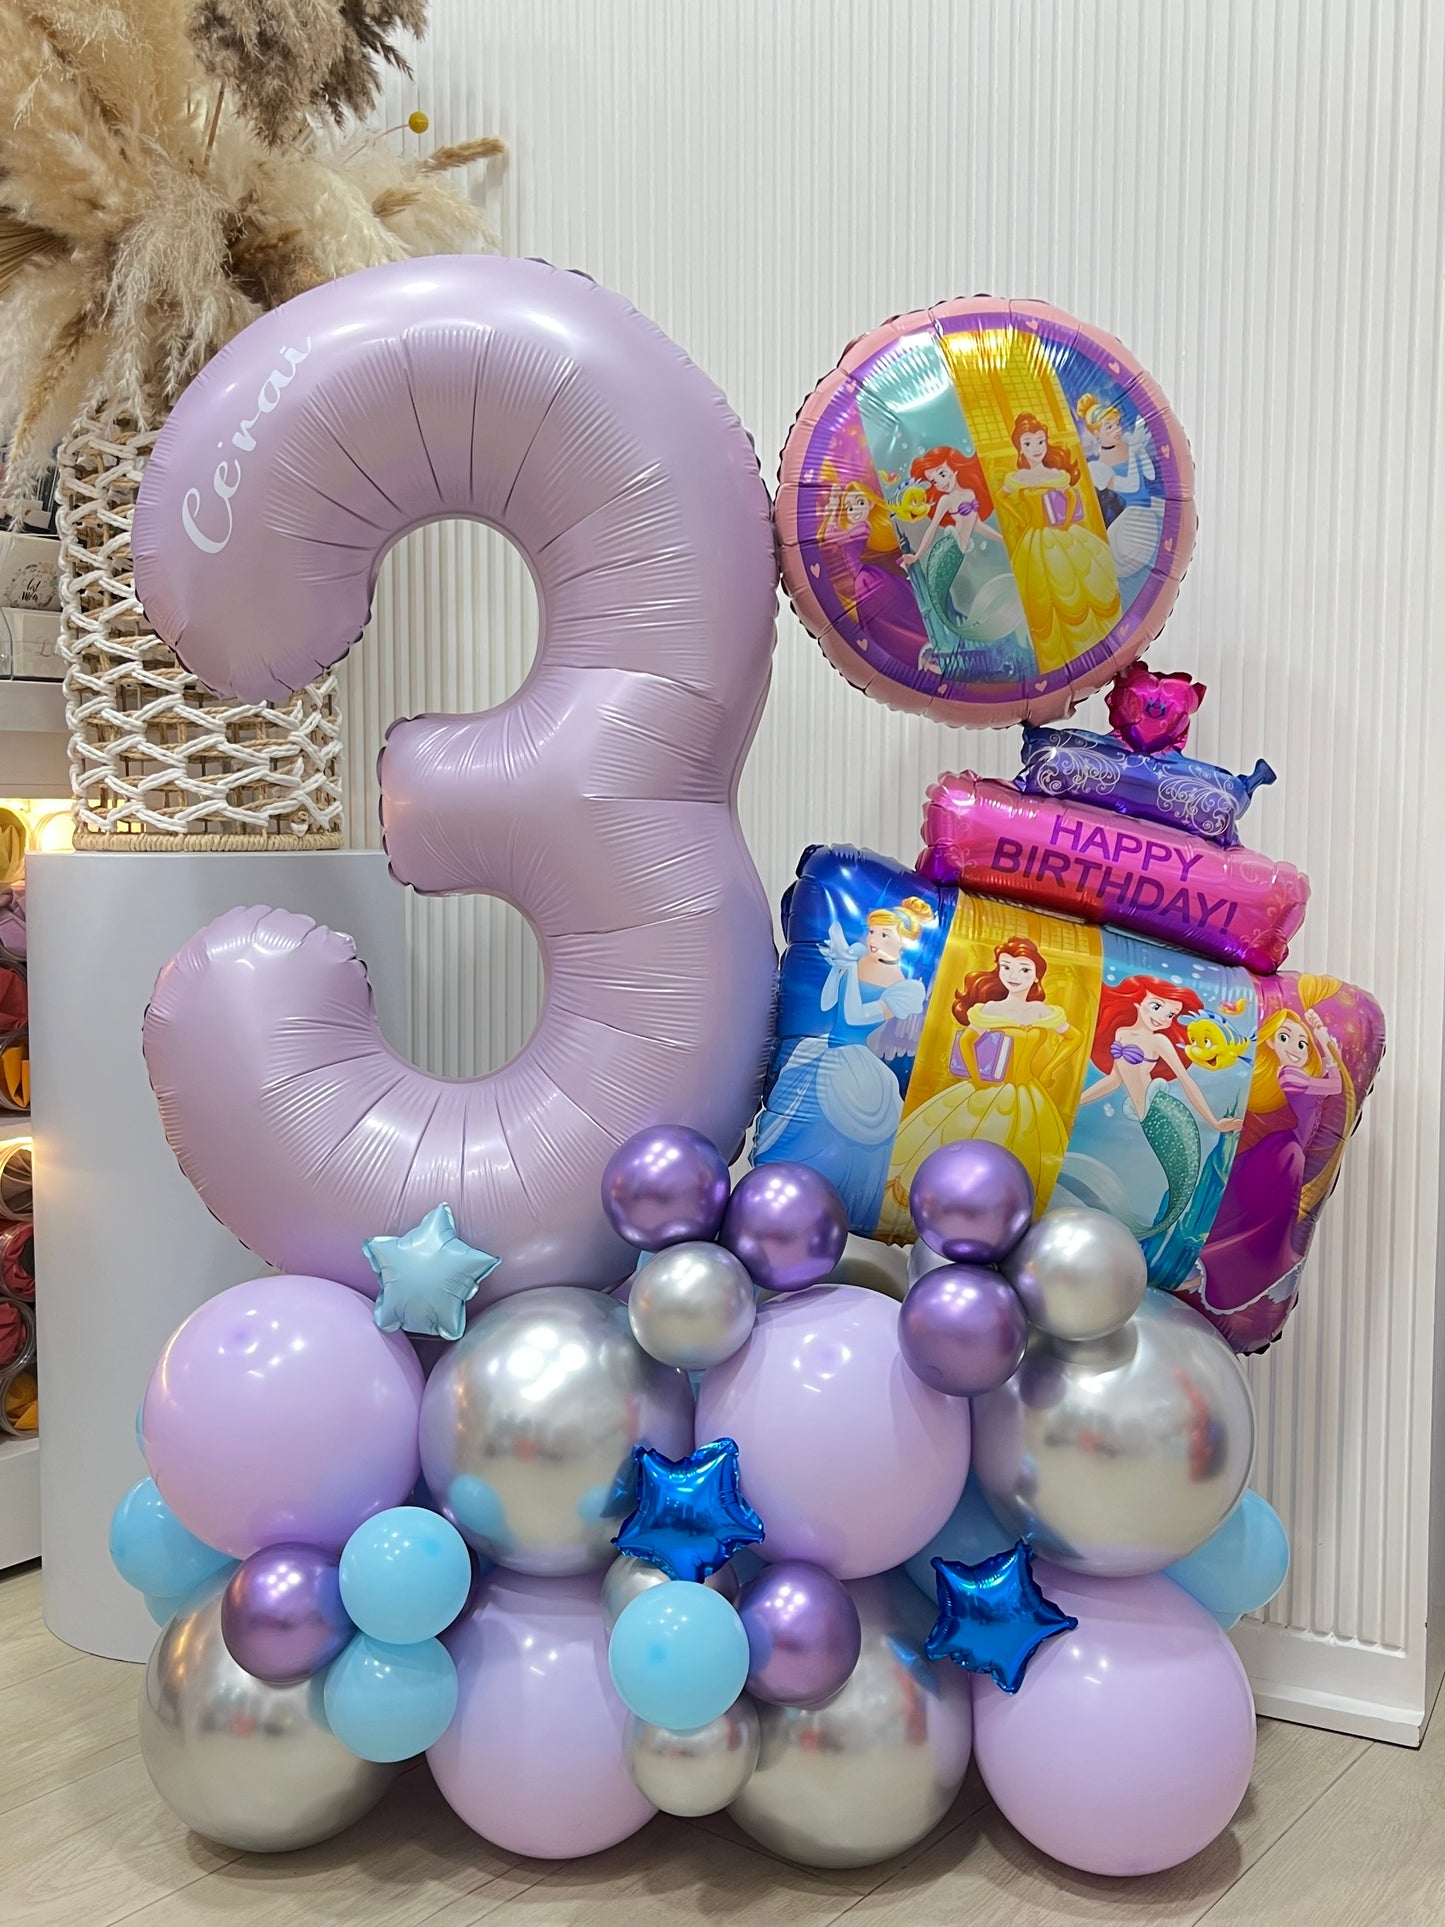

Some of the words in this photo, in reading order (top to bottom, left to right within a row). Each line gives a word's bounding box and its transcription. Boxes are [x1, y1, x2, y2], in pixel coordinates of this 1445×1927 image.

[132, 255, 776, 1298] 3
[991, 837, 1237, 935] BIRTHDAY!
[1050, 815, 1203, 882] HAPPY
